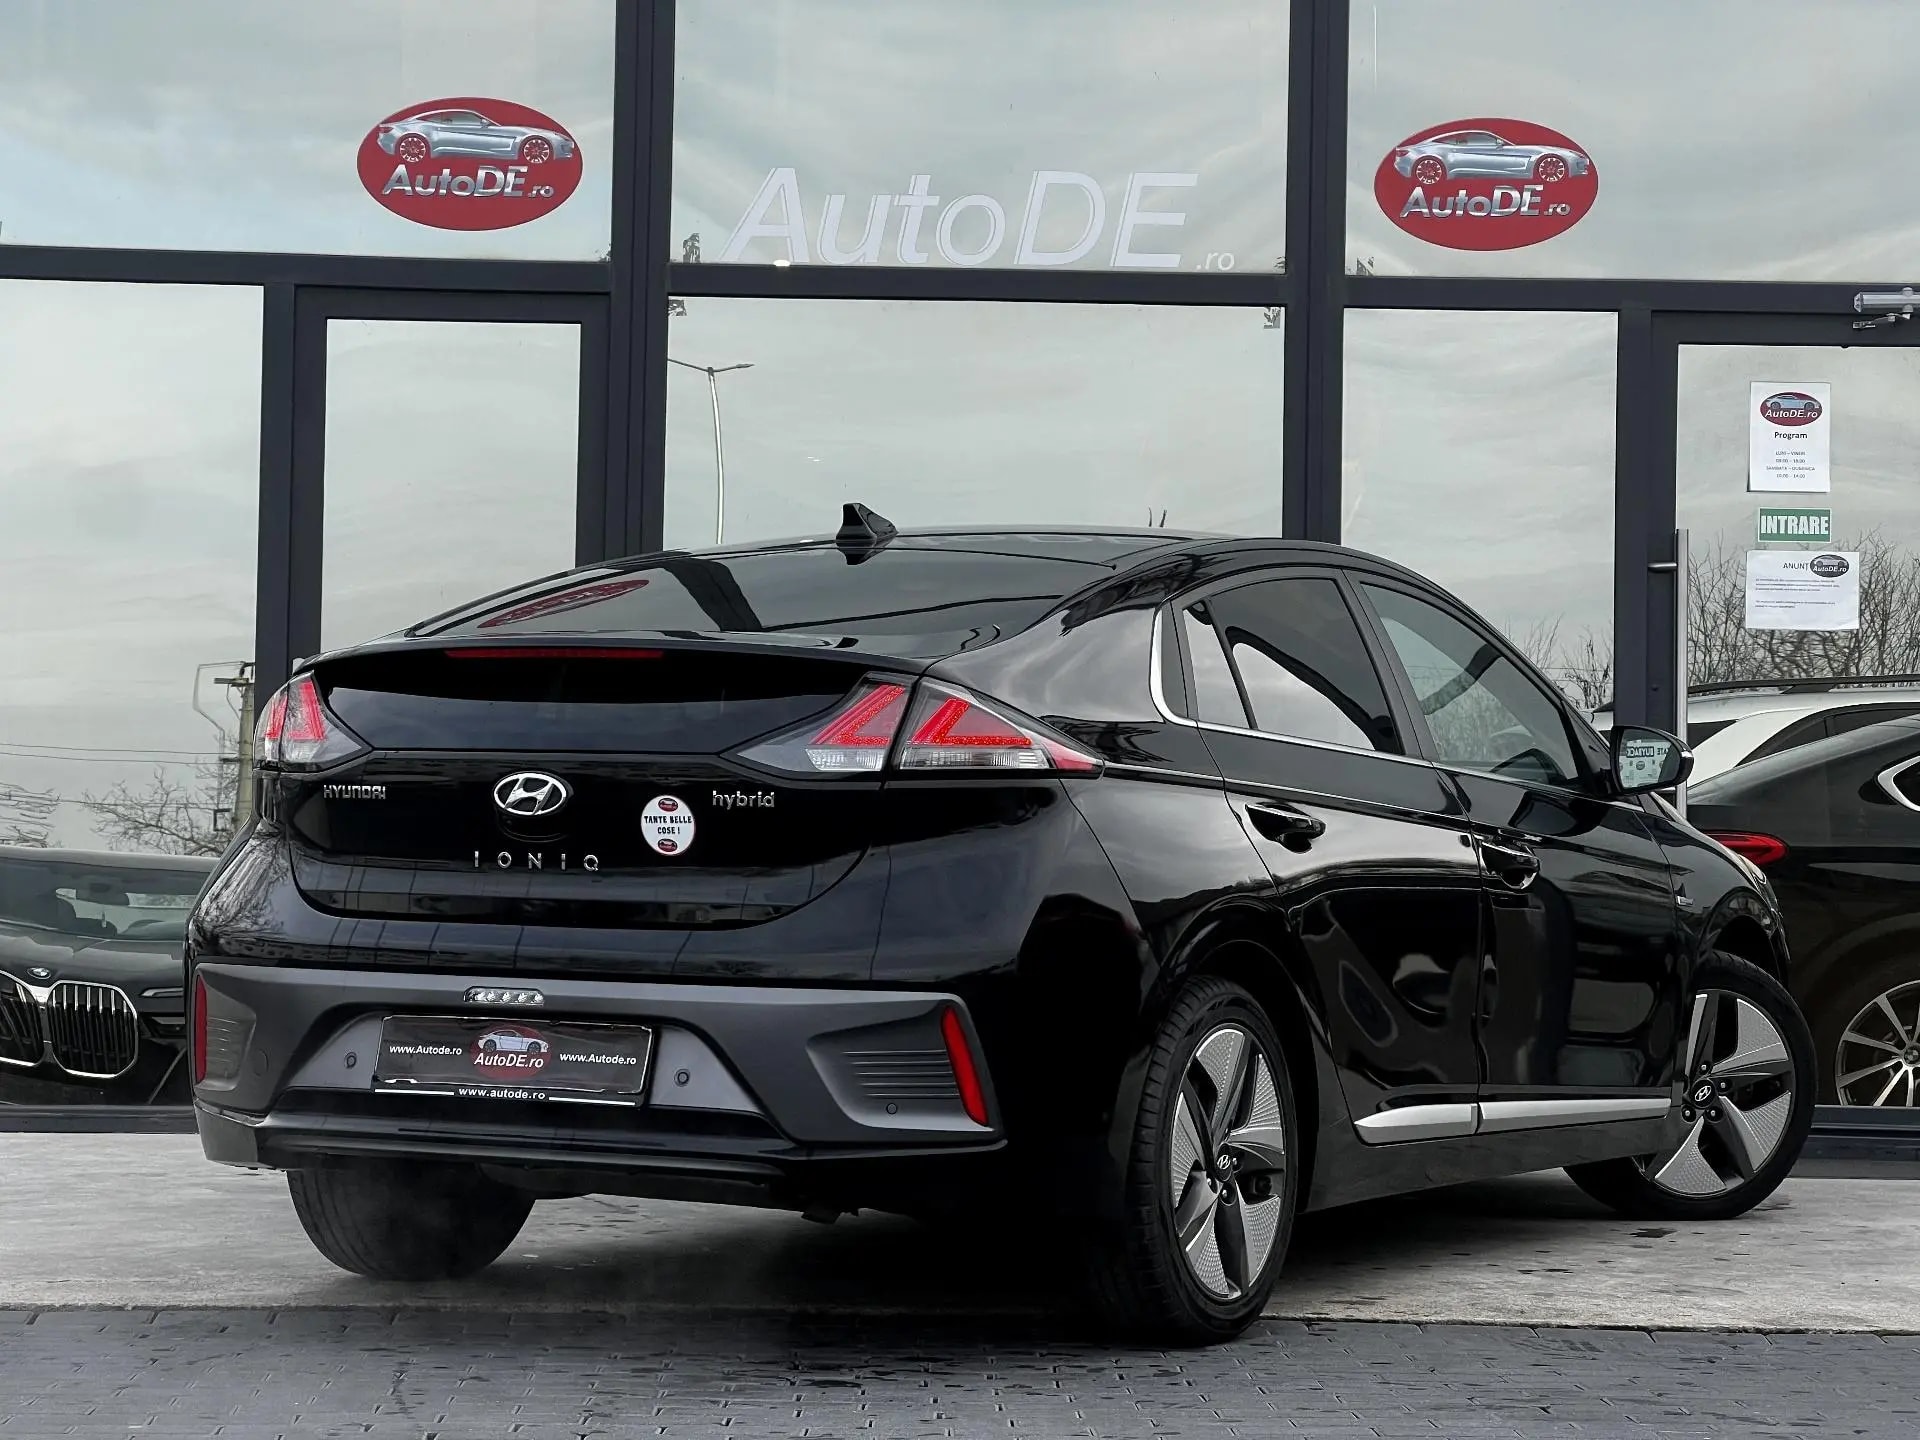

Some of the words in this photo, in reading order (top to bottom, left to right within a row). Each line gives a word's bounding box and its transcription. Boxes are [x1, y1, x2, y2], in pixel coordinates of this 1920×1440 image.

[1764, 409, 1818, 418] AutoDE.ro
[1774, 431, 1808, 440] Program
[1760, 515, 1829, 535] INTRARE
[1813, 564, 1847, 573] AutoDE.ro
[323, 784, 386, 800] HYUNDAI
[712, 790, 775, 810] hybrid
[644, 815, 667, 824] TANTE
[670, 815, 692, 824] BELLE
[474, 850, 599, 872] IONIQ
[389, 1044, 462, 1056] www.Autode.ro
[474, 1053, 544, 1069] AutoDE.ro
[559, 1051, 637, 1065] www.Autode.ro
[458, 1087, 546, 1100] www.autode.ro
